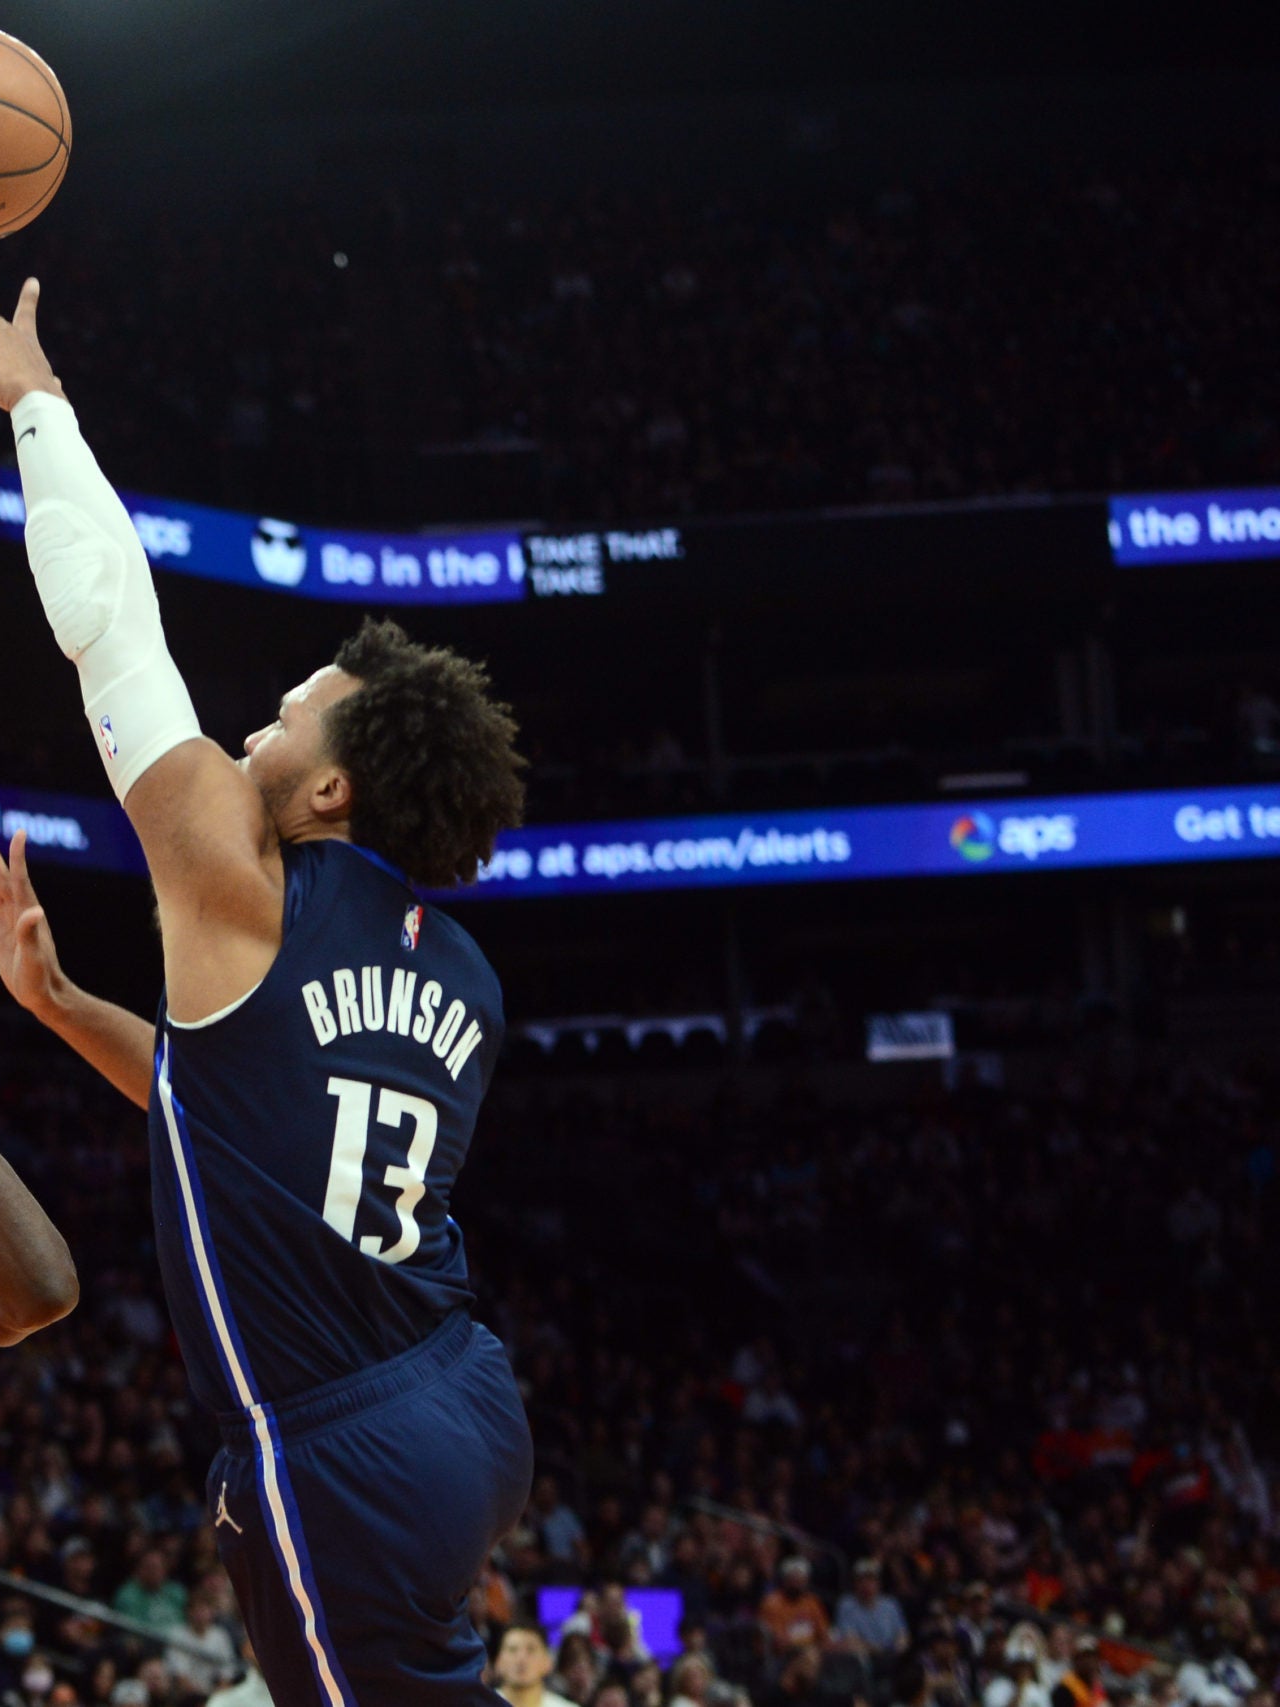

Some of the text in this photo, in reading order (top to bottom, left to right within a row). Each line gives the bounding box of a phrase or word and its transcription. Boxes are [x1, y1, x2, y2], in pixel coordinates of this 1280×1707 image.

[1128, 506, 1201, 548] the
[321, 543, 375, 585] Be
[380, 545, 421, 586] in
[426, 546, 500, 588] the
[997, 814, 1077, 860] aps
[1173, 804, 1243, 843] Get
[537, 842, 577, 878] at
[302, 966, 482, 1081] BRUNSON
[323, 1076, 438, 1265] 13
